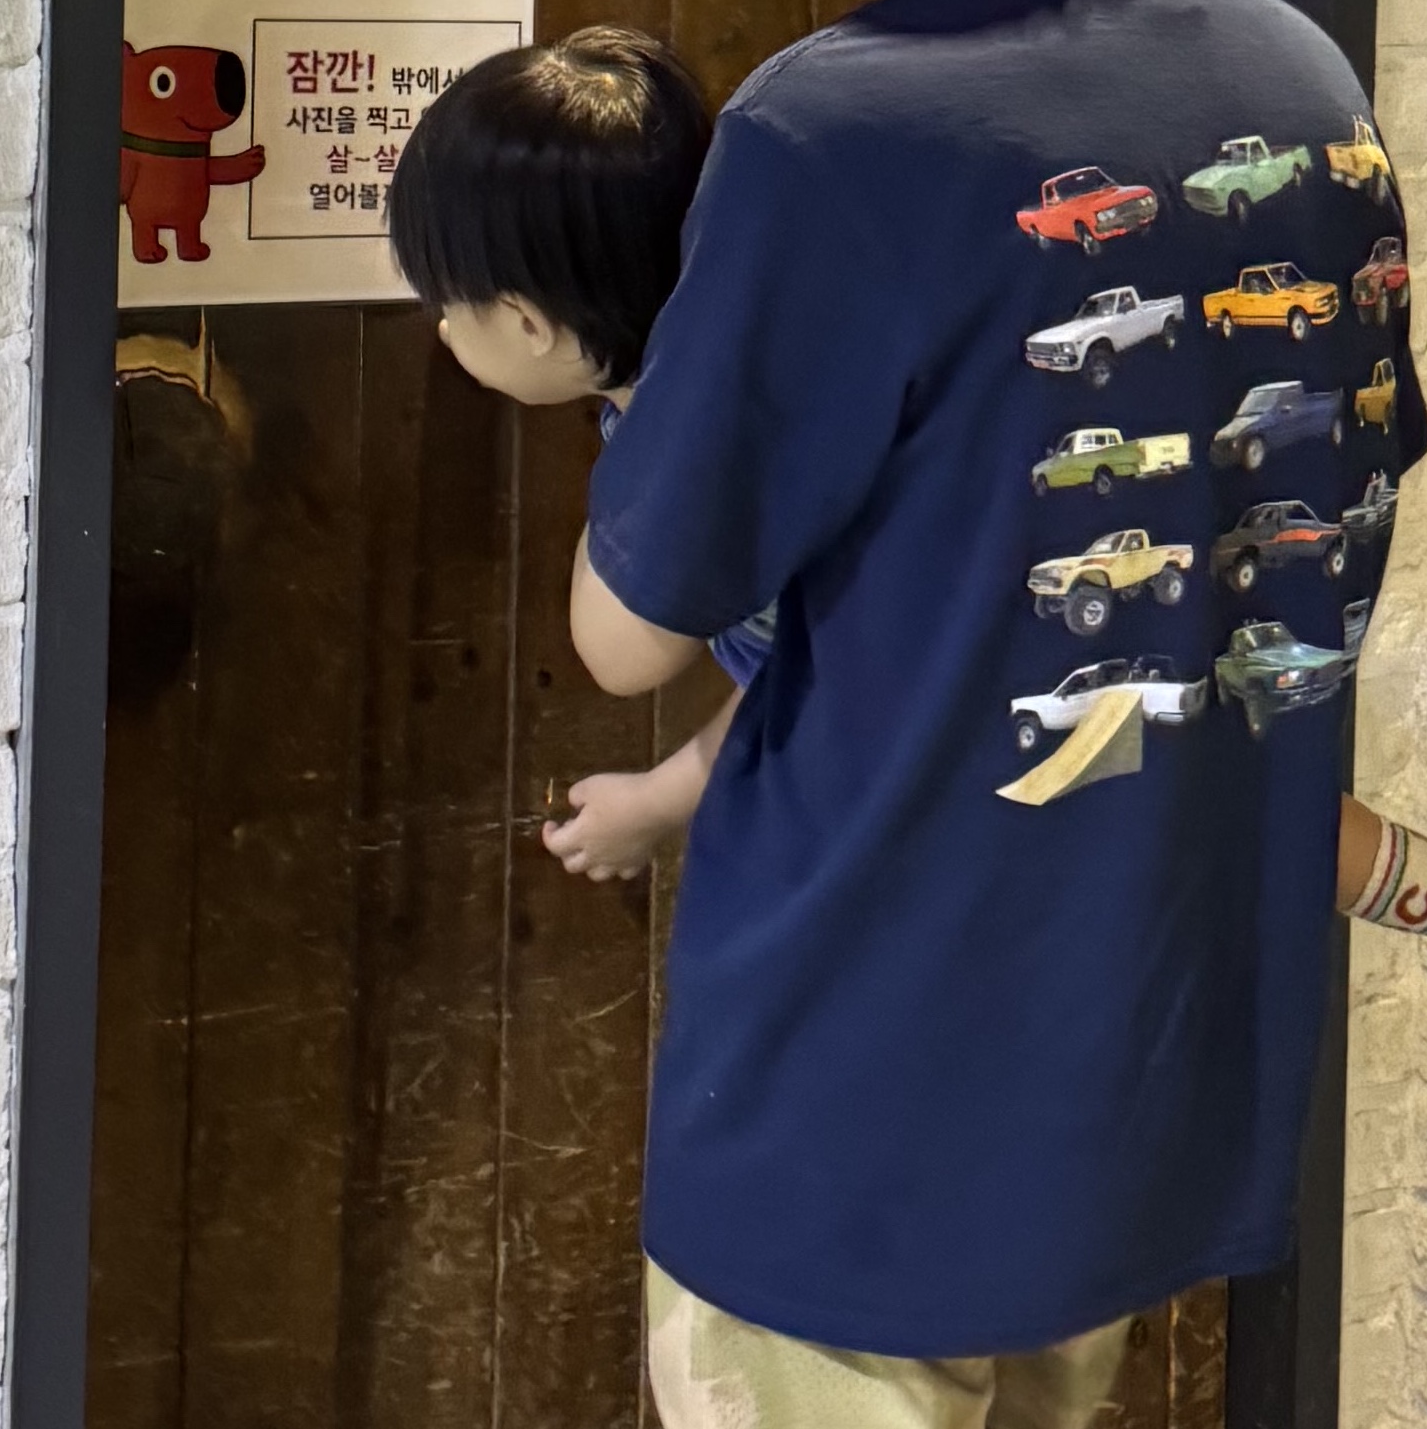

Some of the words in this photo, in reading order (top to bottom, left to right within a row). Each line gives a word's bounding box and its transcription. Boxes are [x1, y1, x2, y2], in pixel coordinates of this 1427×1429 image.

[286, 50, 376, 94] 잠깐!
[286, 106, 358, 134] 사진을
[366, 106, 413, 134] 찍고
[310, 183, 390, 210] 열어볼
